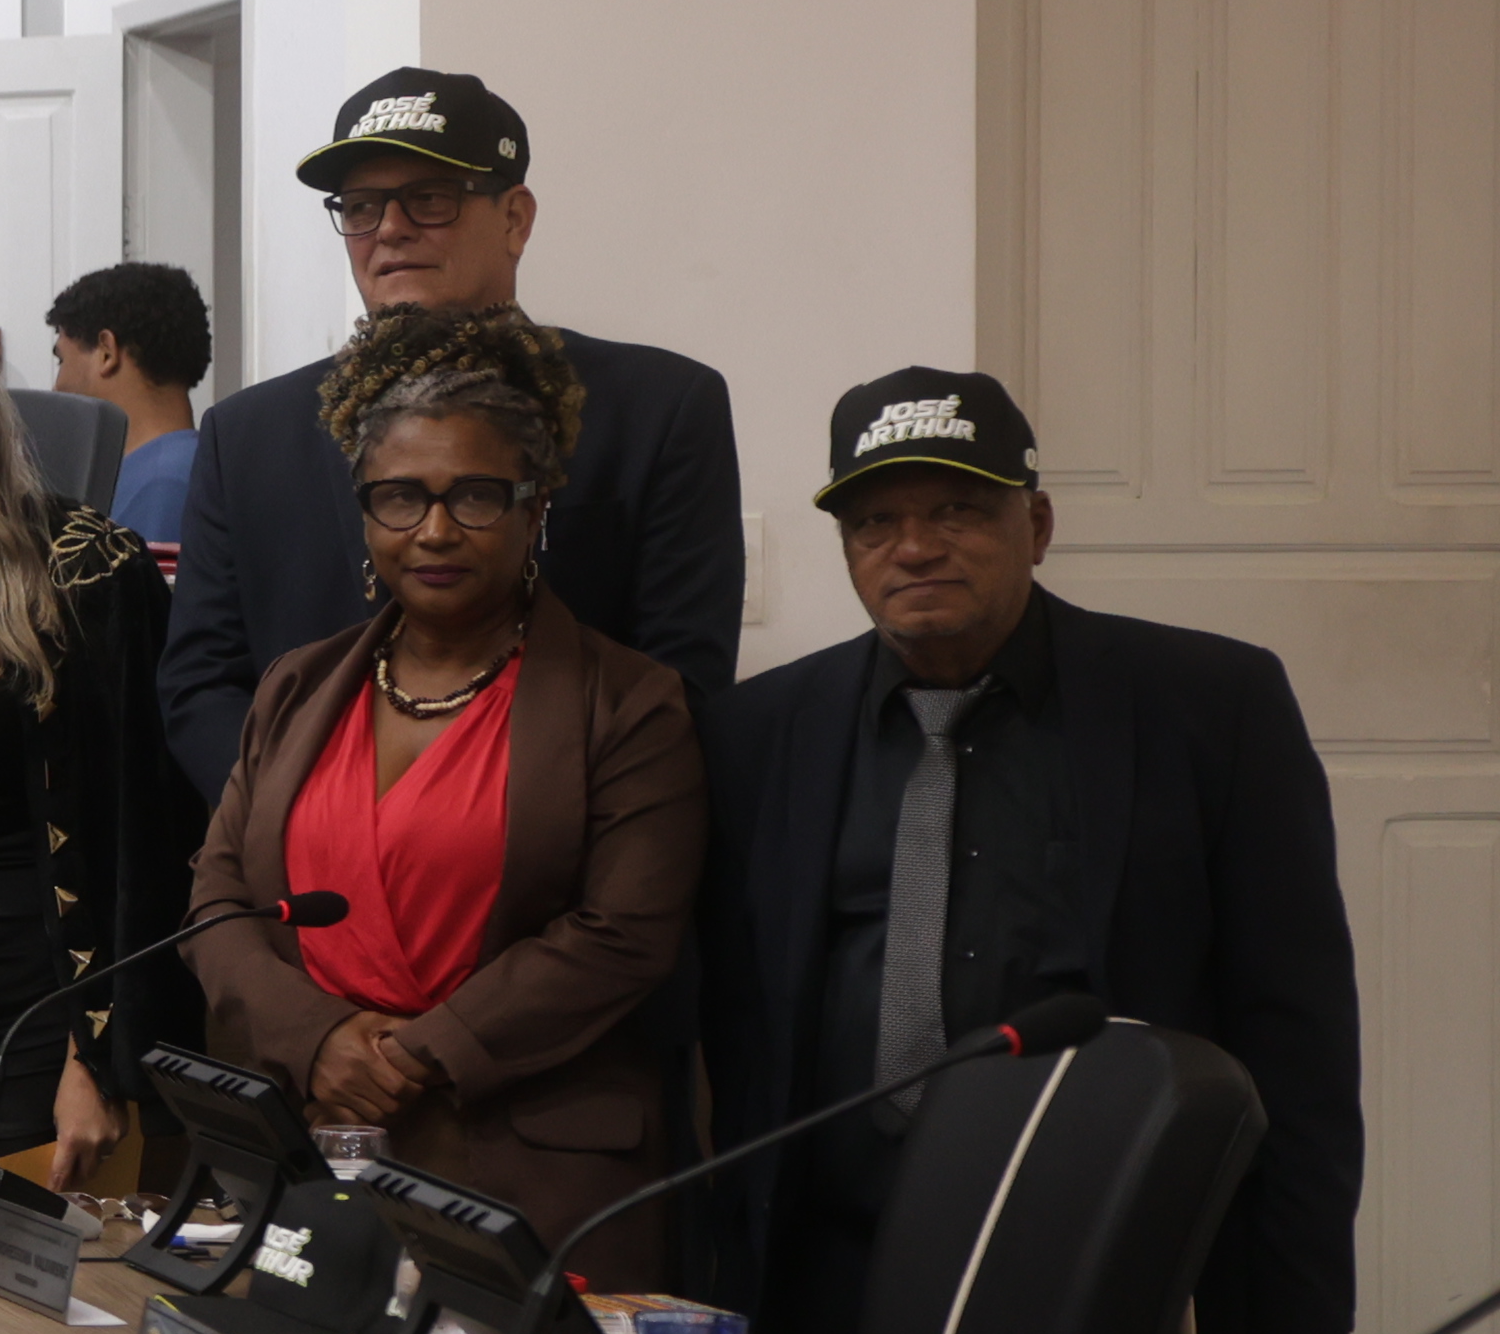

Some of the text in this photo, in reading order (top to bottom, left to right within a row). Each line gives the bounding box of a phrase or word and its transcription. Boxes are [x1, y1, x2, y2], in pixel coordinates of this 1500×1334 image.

[359, 92, 437, 123] JOSÉ
[349, 112, 447, 138] ARTHUR
[869, 394, 961, 429] JOSÉ
[854, 418, 976, 458] ARTHUR
